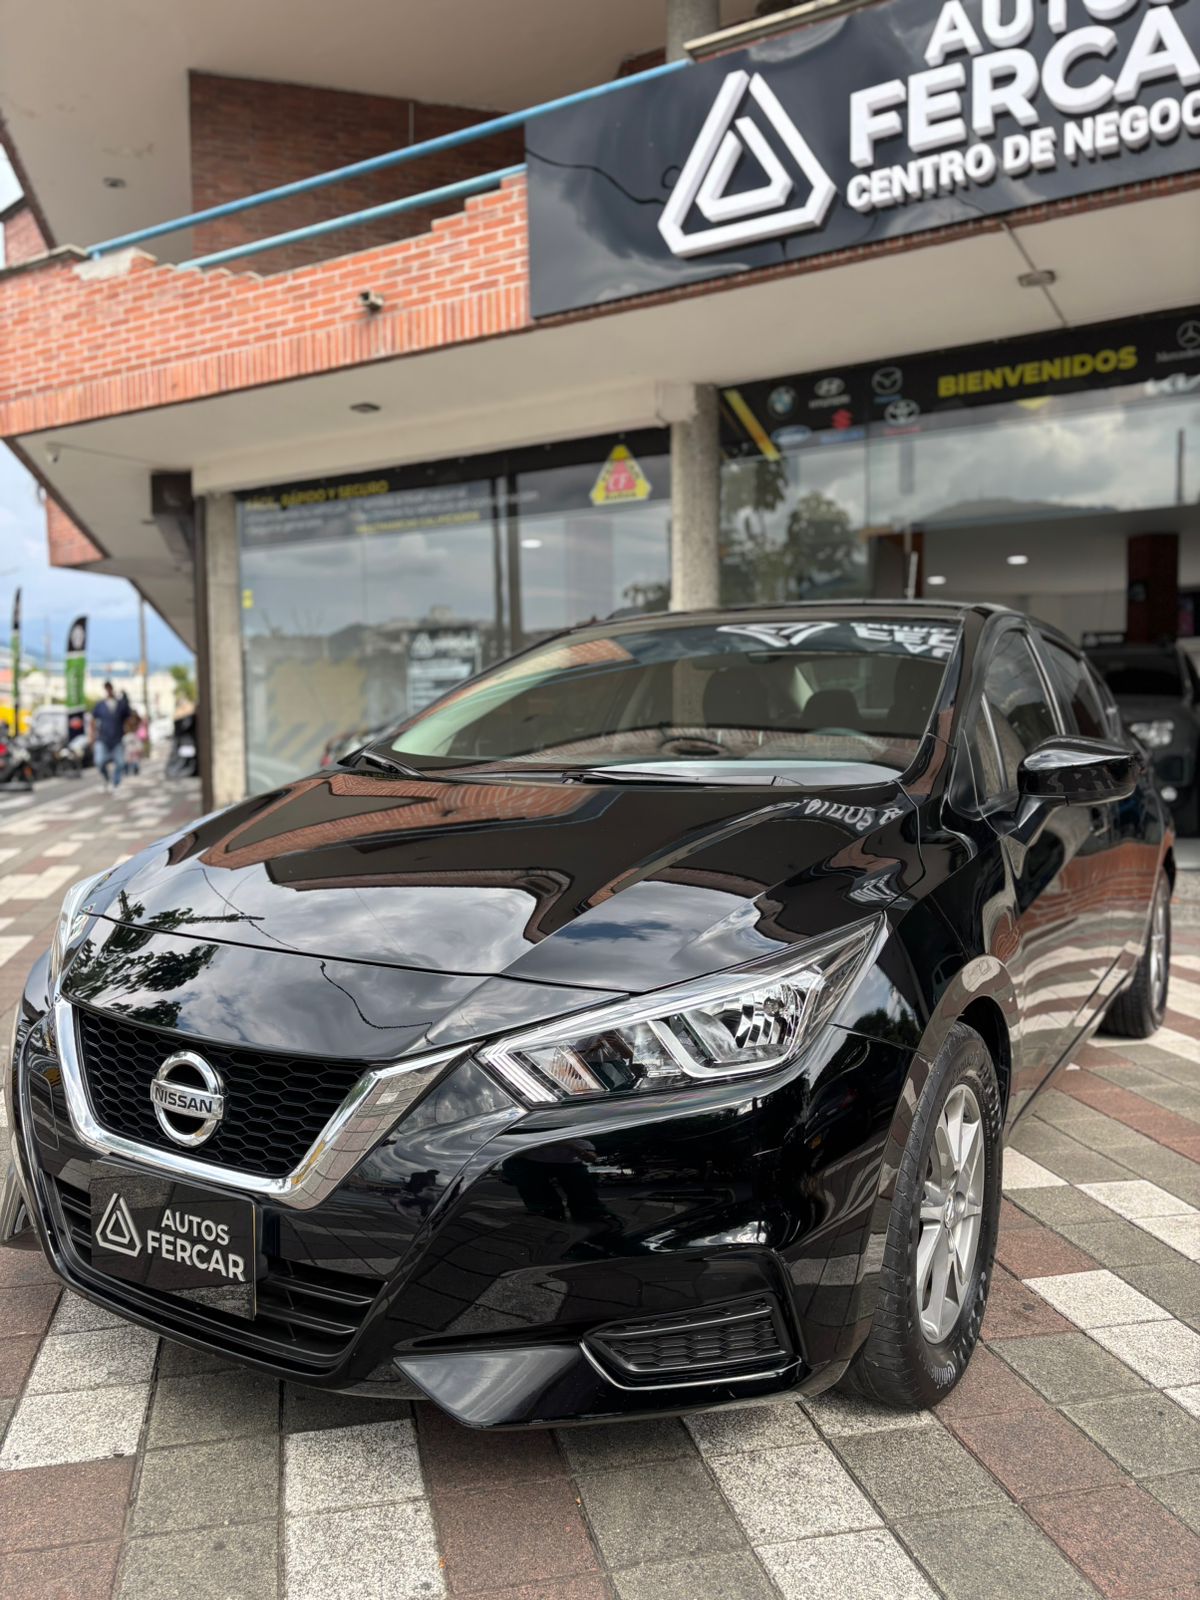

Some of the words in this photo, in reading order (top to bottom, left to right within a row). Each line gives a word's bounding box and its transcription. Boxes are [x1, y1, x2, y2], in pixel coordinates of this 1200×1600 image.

[847, 142, 996, 212] CENTRO
[1003, 126, 1057, 176] DE
[936, 346, 1139, 398] BIENVENIDOS
[154, 1086, 213, 1114] NISSAN
[161, 1208, 230, 1246] AUTOS
[146, 1229, 246, 1283] FERCAR
